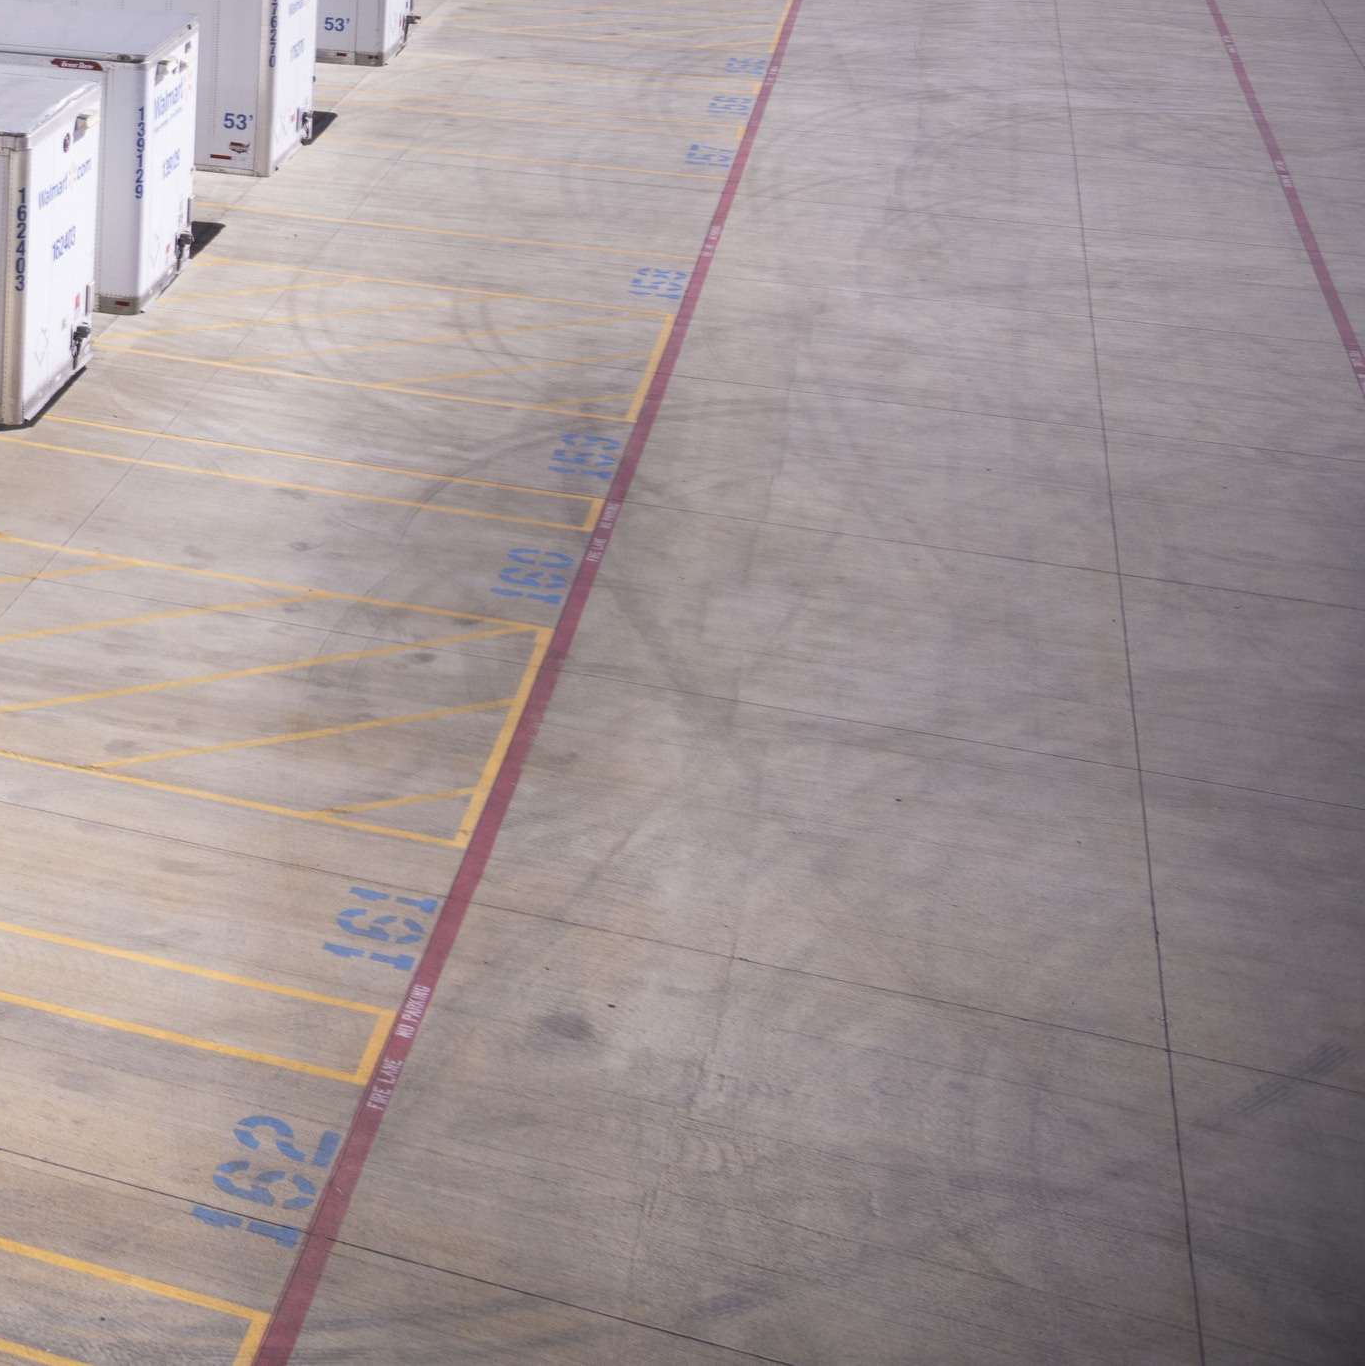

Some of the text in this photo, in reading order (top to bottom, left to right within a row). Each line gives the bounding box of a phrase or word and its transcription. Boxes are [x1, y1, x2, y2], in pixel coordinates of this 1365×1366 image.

[324, 17, 350, 32] 53'
[154, 77, 184, 122] Walmart
[223, 112, 253, 130] 53'
[135, 106, 145, 199] 139129
[38, 158, 92, 210] Walmart com
[15, 187, 27, 292] 162403
[490, 548, 575, 606] 160
[323, 886, 438, 972] 161
[394, 984, 431, 1039] NO PARKING
[366, 1058, 404, 1111] FIRE LANE
[191, 1115, 341, 1250] 162
